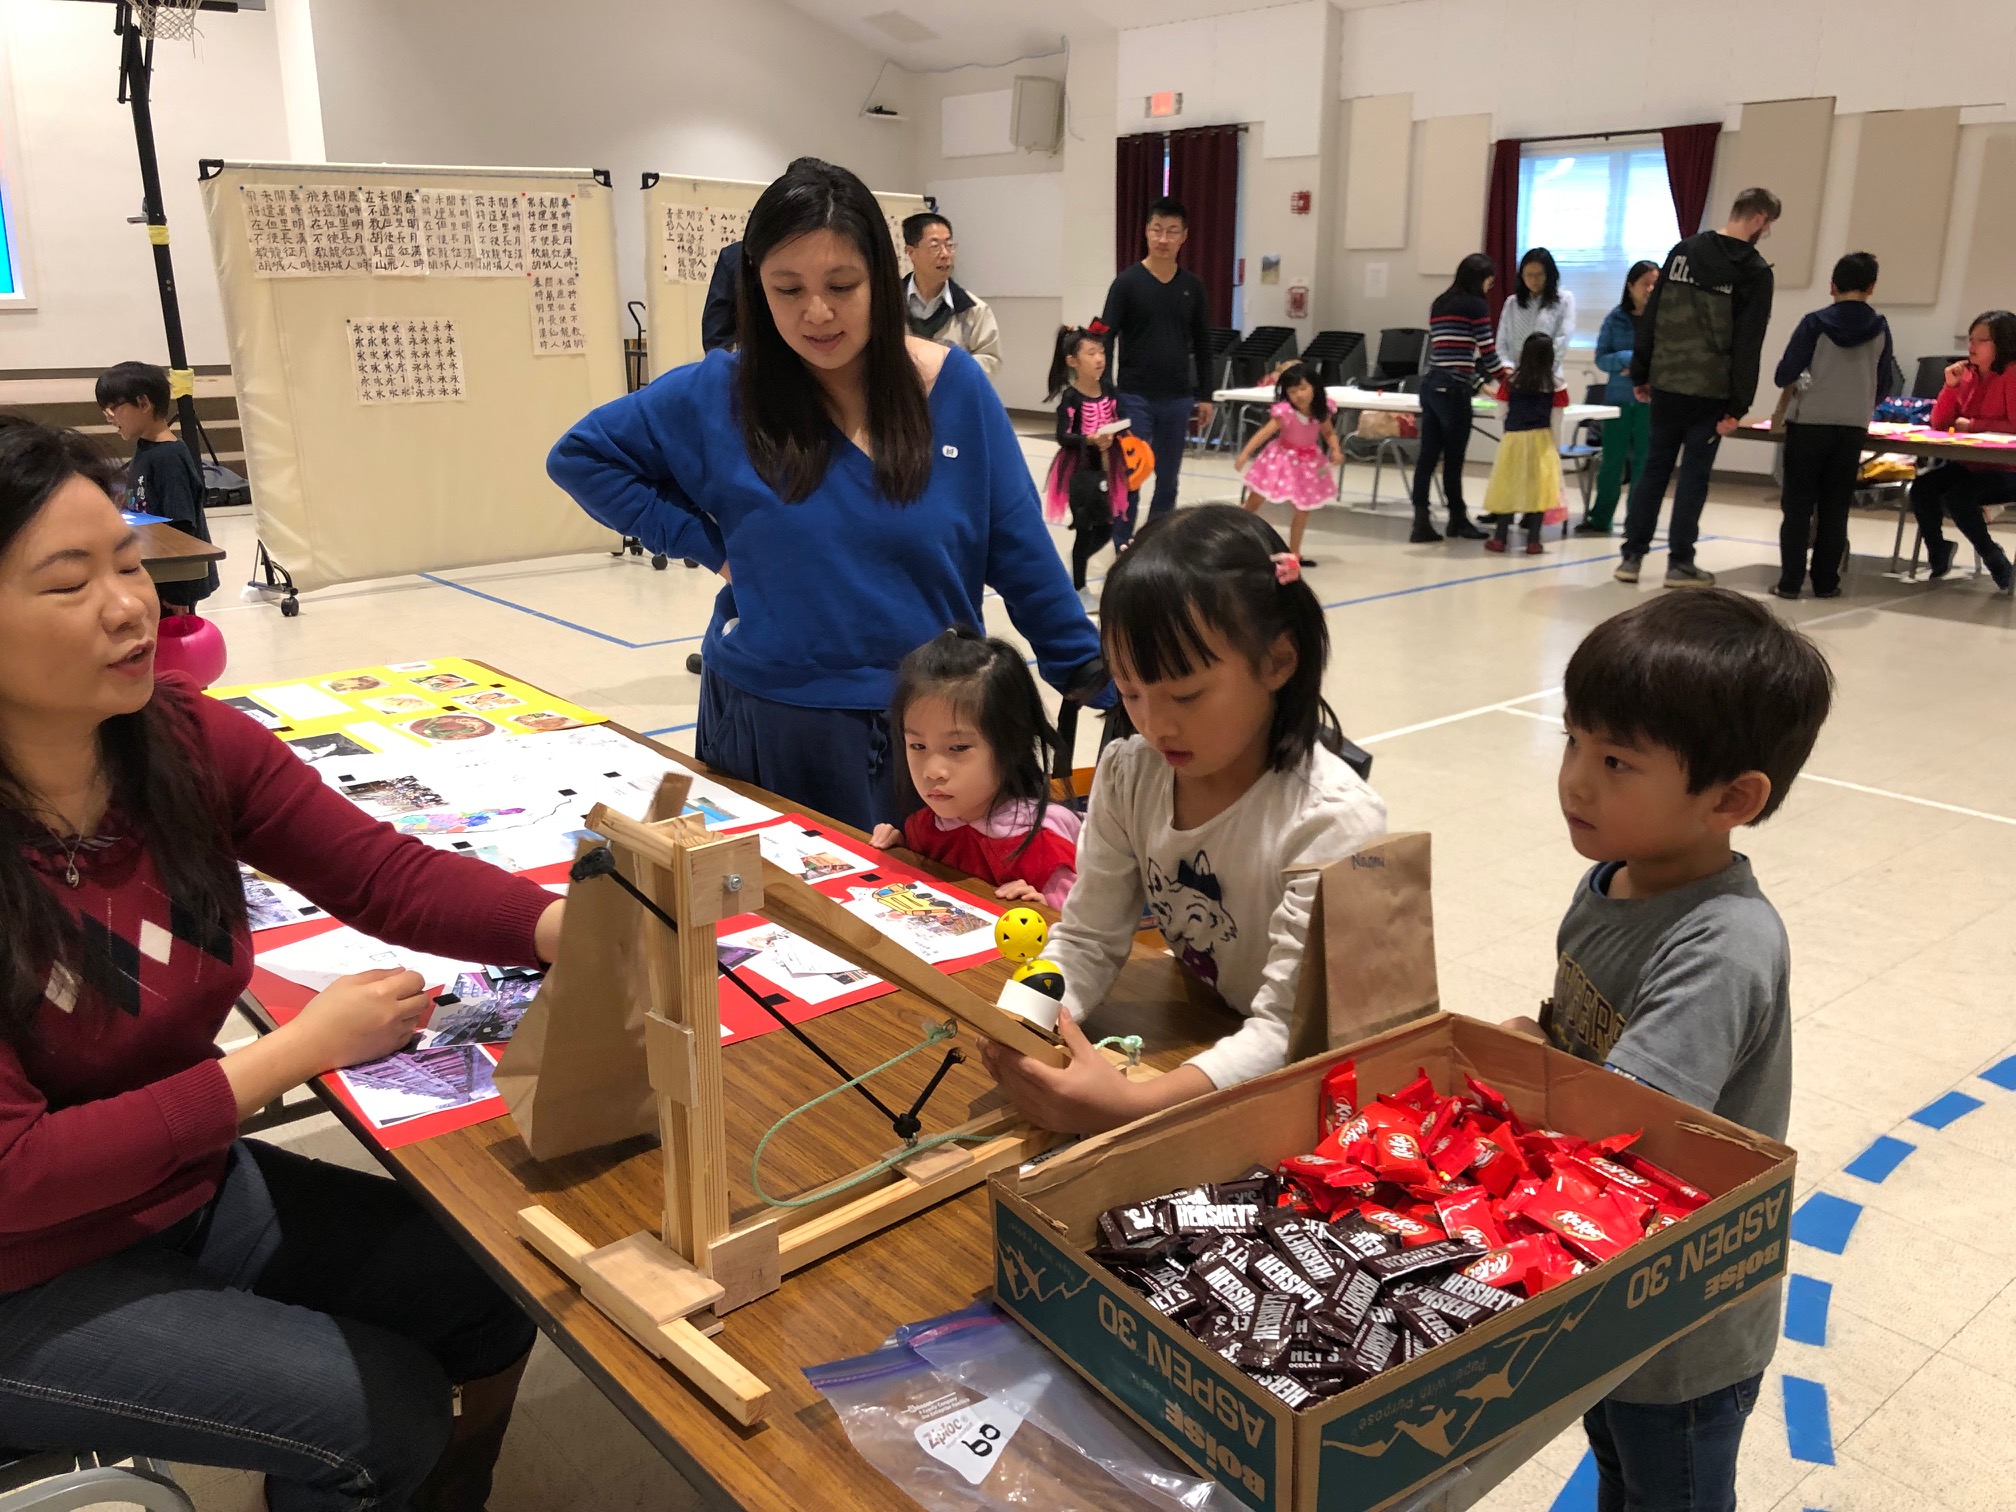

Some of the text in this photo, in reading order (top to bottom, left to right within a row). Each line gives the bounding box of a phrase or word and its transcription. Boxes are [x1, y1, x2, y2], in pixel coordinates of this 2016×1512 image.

[1176, 1203, 1262, 1226] HERSHEY'S
[1626, 1185, 1787, 1309] ASPEN 30
[1204, 1266, 1256, 1314] HERSH
[1254, 1253, 1325, 1311] HERSHEY
[1336, 1270, 1381, 1327] HERSHEY'S
[1252, 1294, 1291, 1340] HERSHEY'S
[1098, 1294, 1266, 1449] ASPEN 30
